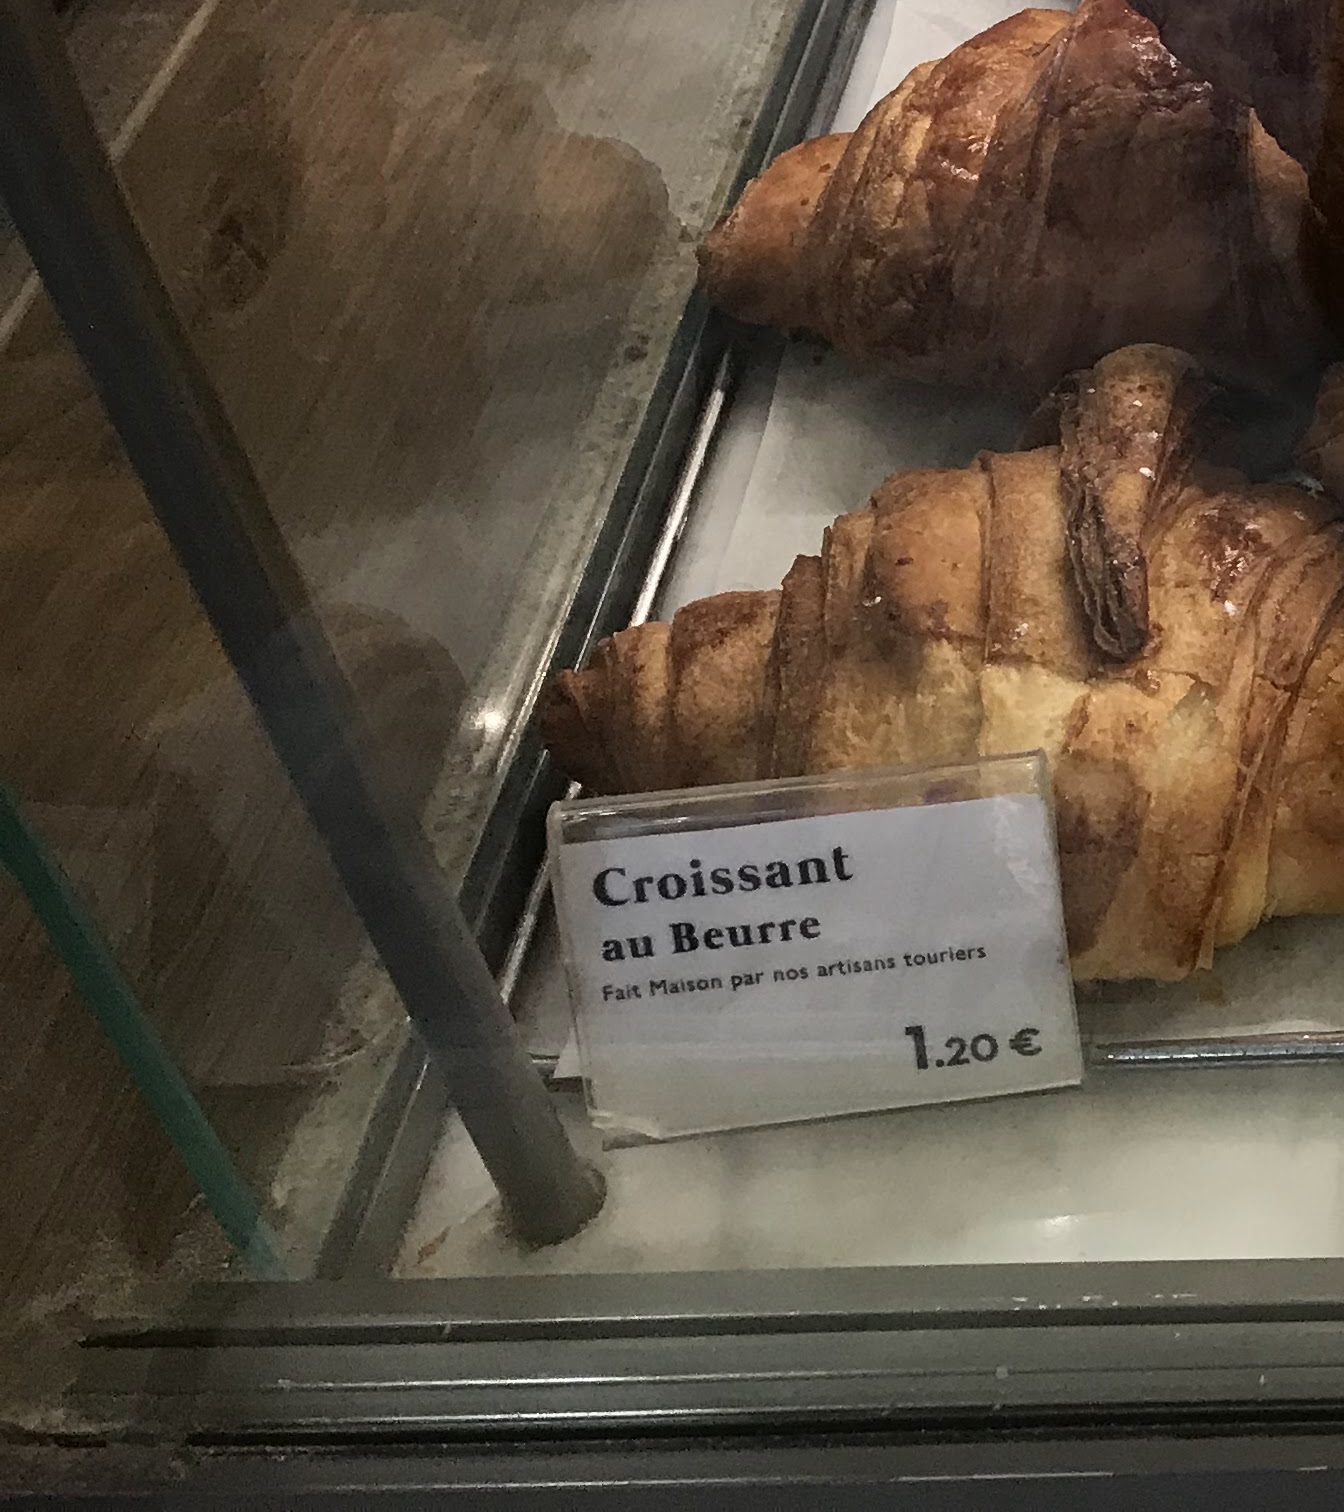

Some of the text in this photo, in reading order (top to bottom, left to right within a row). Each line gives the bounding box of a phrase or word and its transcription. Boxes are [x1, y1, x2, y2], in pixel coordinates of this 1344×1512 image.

[593, 846, 853, 906] Croissant
[602, 917, 821, 962] au Beurre
[603, 944, 987, 1002] Fait Maison par nos artisans touriers
